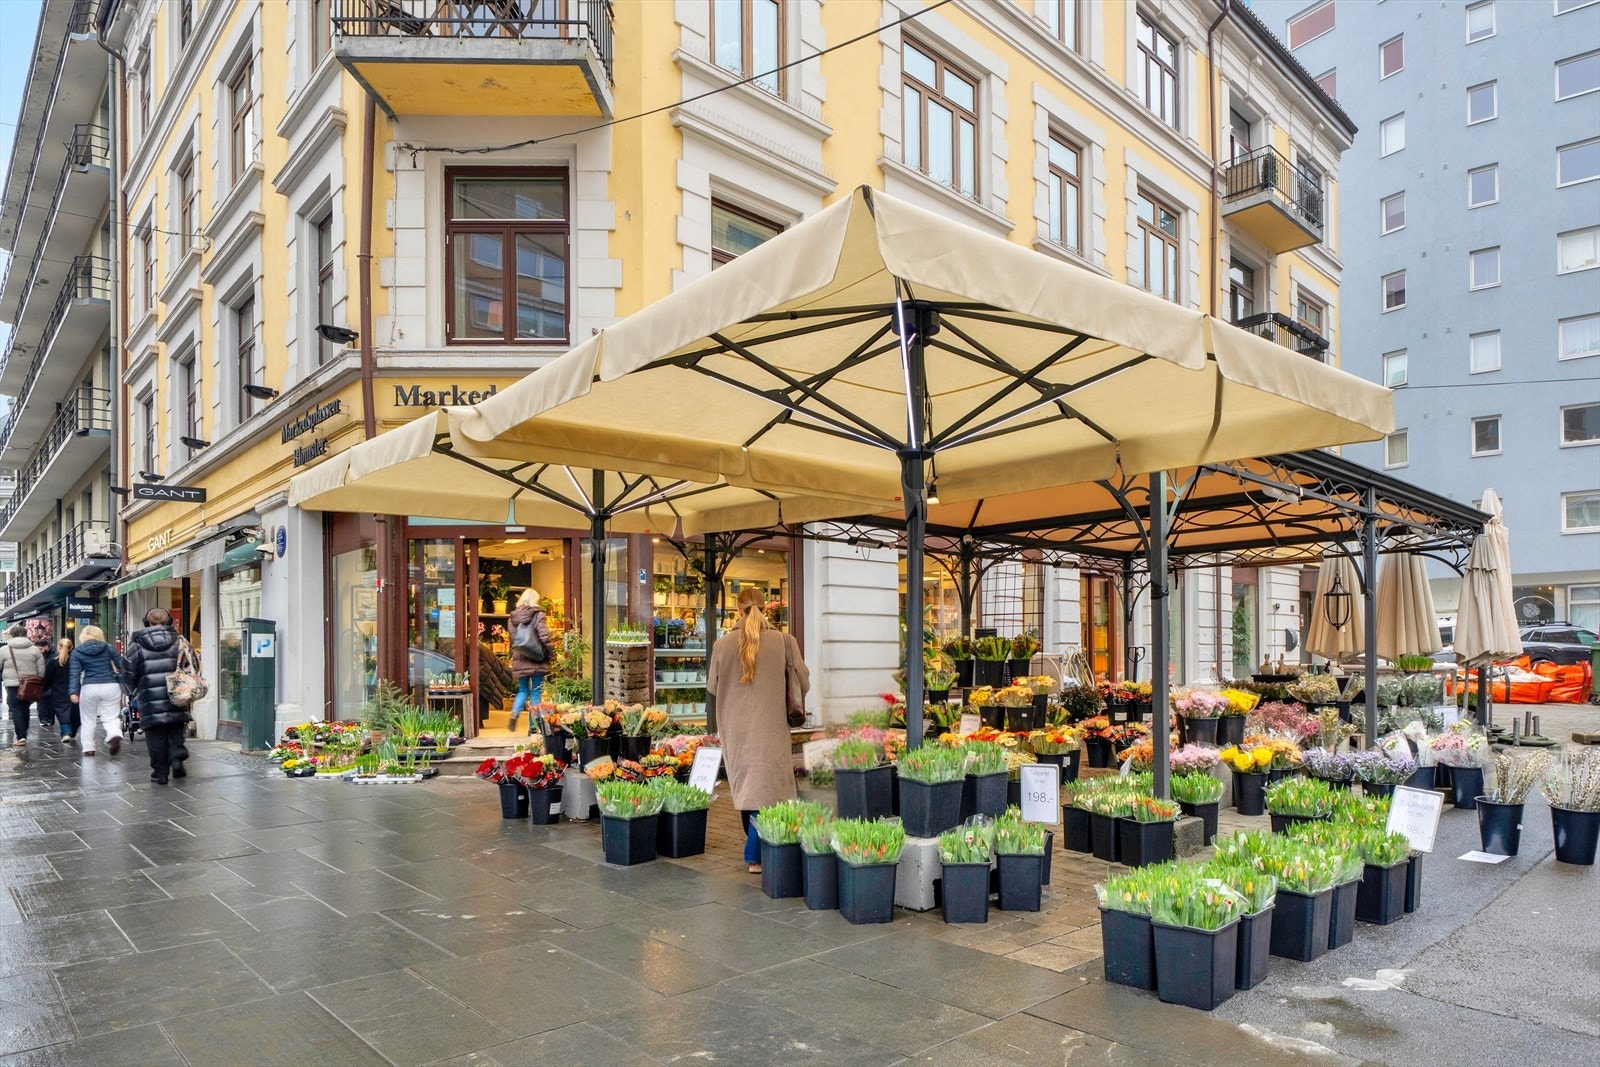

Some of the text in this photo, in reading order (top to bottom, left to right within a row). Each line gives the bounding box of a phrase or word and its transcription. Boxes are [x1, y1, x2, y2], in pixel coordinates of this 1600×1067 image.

[138, 487, 200, 499] GANT
[147, 528, 172, 552] GANT
[1027, 791, 1054, 803] 198.-
